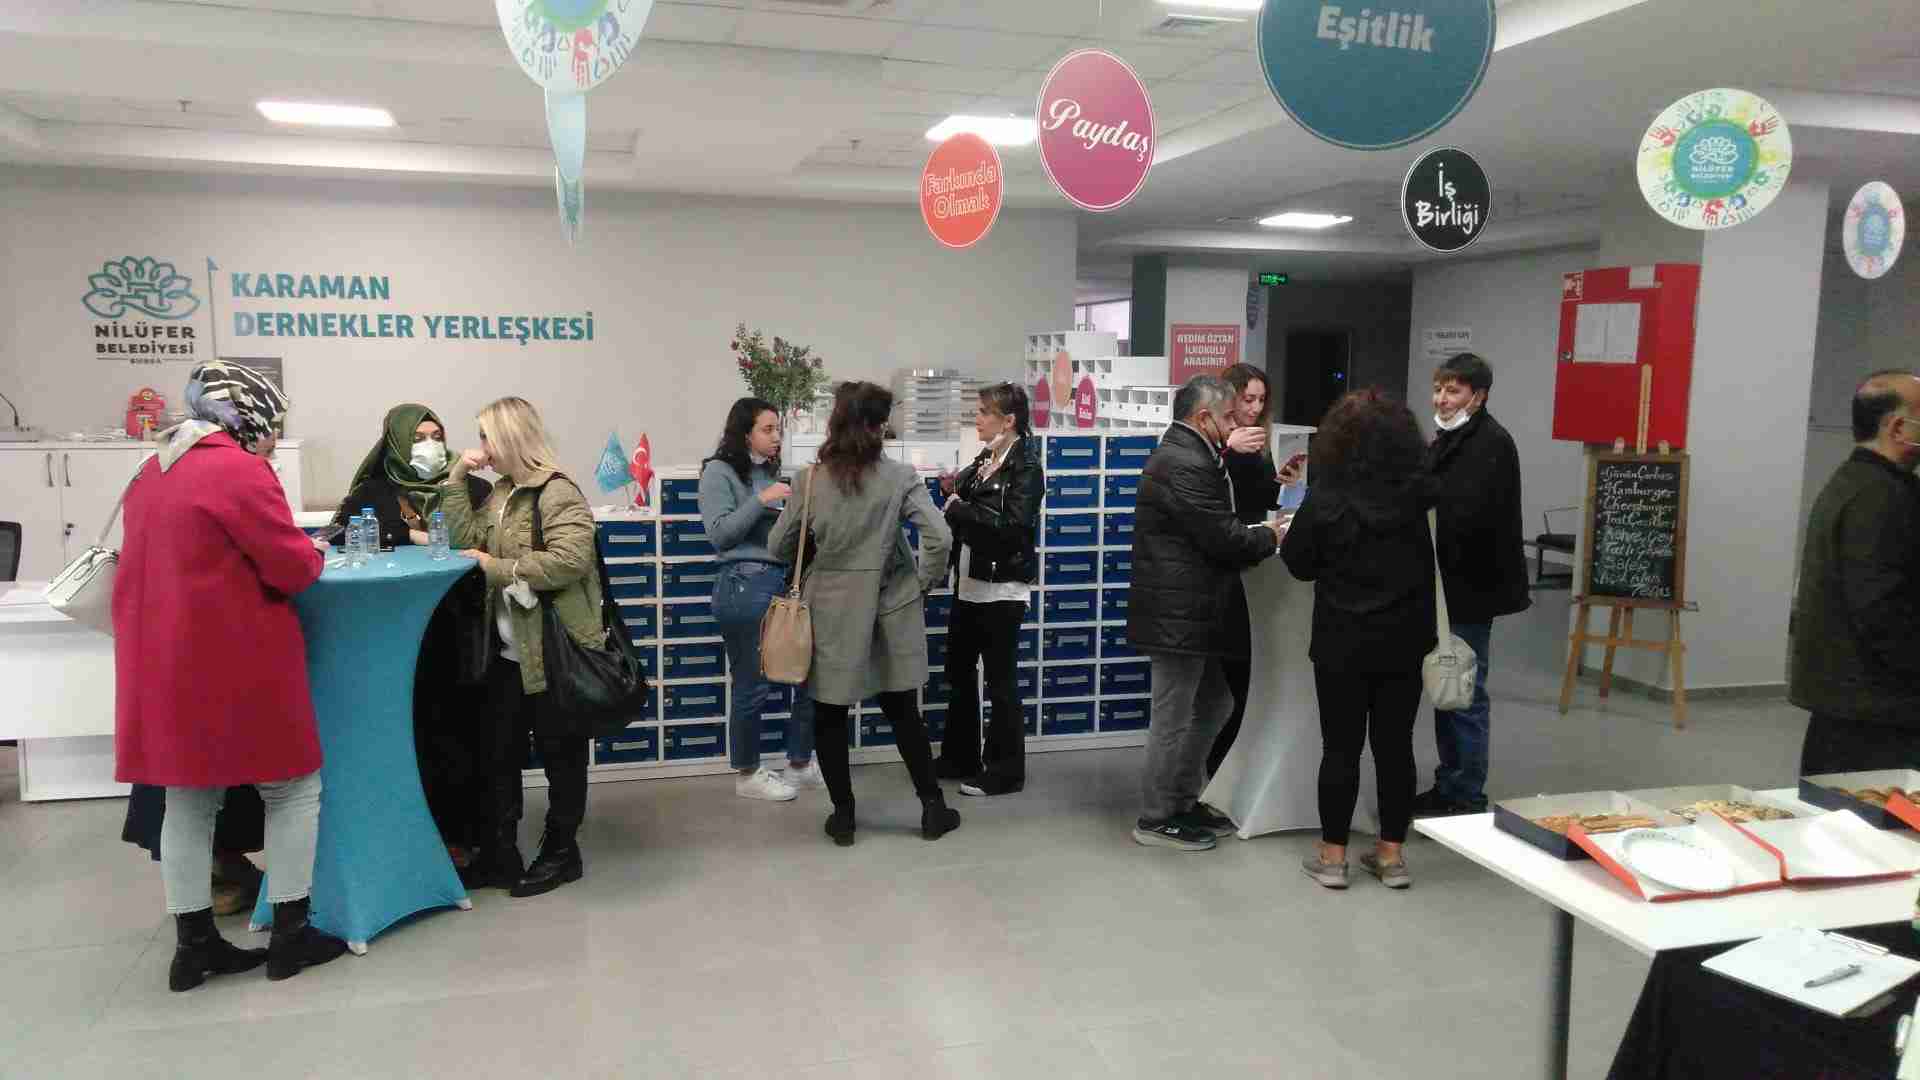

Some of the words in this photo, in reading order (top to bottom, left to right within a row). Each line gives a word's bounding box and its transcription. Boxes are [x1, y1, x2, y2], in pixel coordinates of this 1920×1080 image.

[1317, 5, 1435, 52] Eşitlik
[1042, 98, 1150, 162] Paydaş
[926, 159, 997, 196] Farkında
[1439, 162, 1456, 202] İş
[934, 187, 993, 219] Olmak
[1415, 200, 1479, 235] Birliği
[232, 272, 390, 300] KARAMAN
[94, 321, 195, 339] NİLÜFER
[234, 311, 415, 338] DERNEKLER
[423, 311, 594, 346] YERLEŞKESİ
[96, 340, 194, 354] BELEDİYESİ
[1603, 481, 1676, 502] Hamburger
